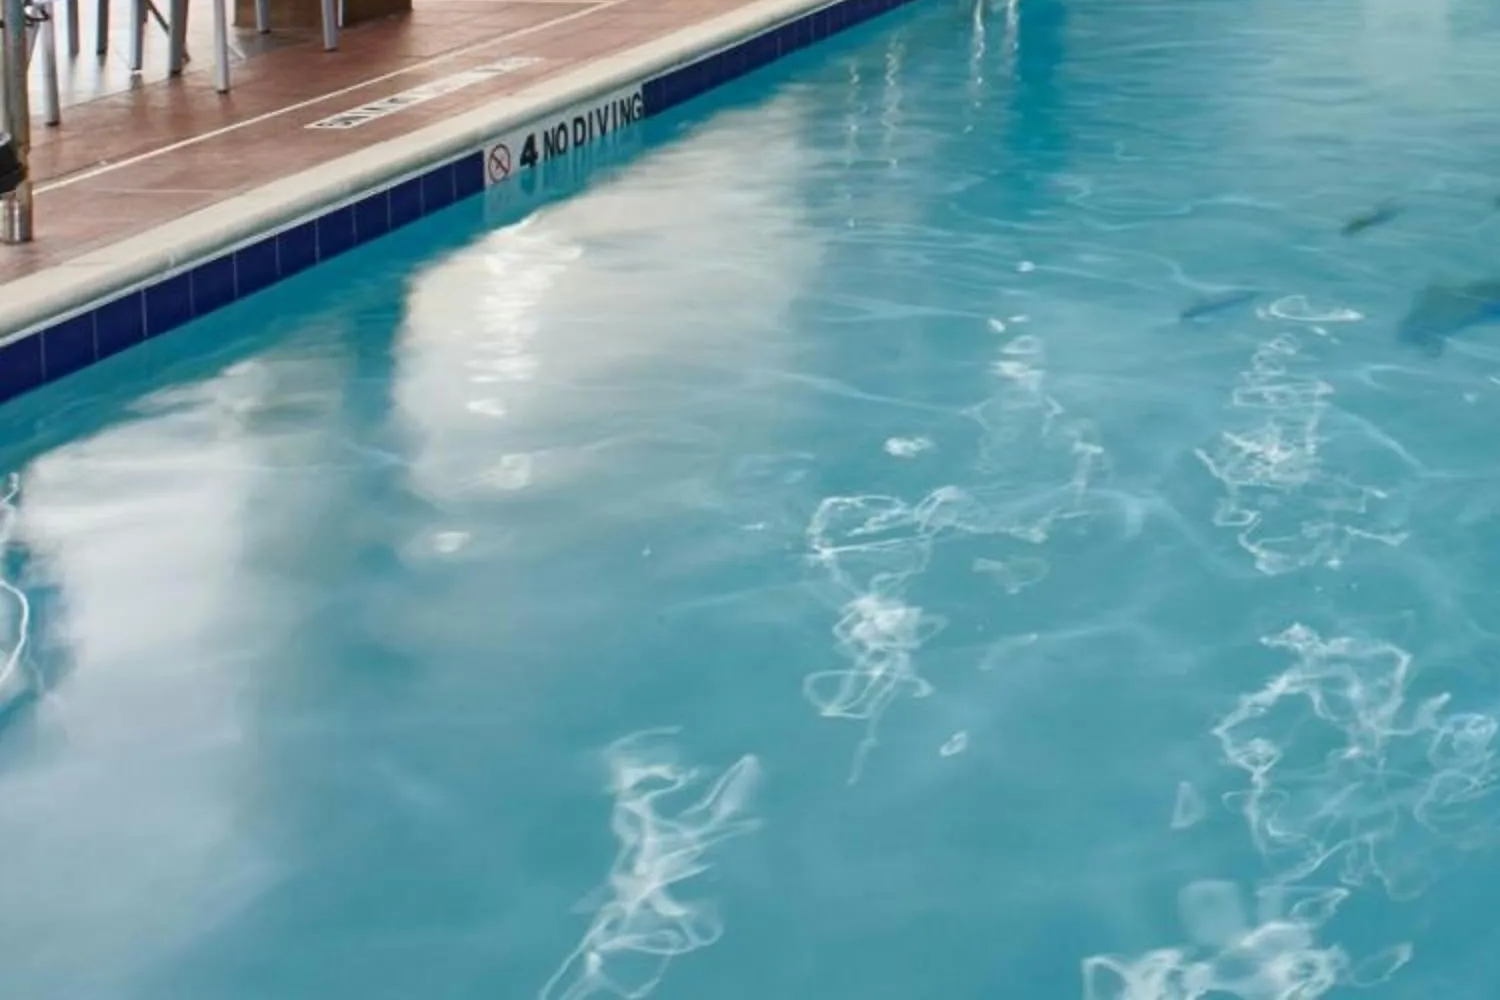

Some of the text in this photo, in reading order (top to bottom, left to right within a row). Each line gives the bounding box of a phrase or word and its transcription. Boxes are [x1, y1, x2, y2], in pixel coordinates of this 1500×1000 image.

[519, 132, 539, 169] 4
[543, 122, 569, 162] NO
[573, 91, 643, 149] DIVING
